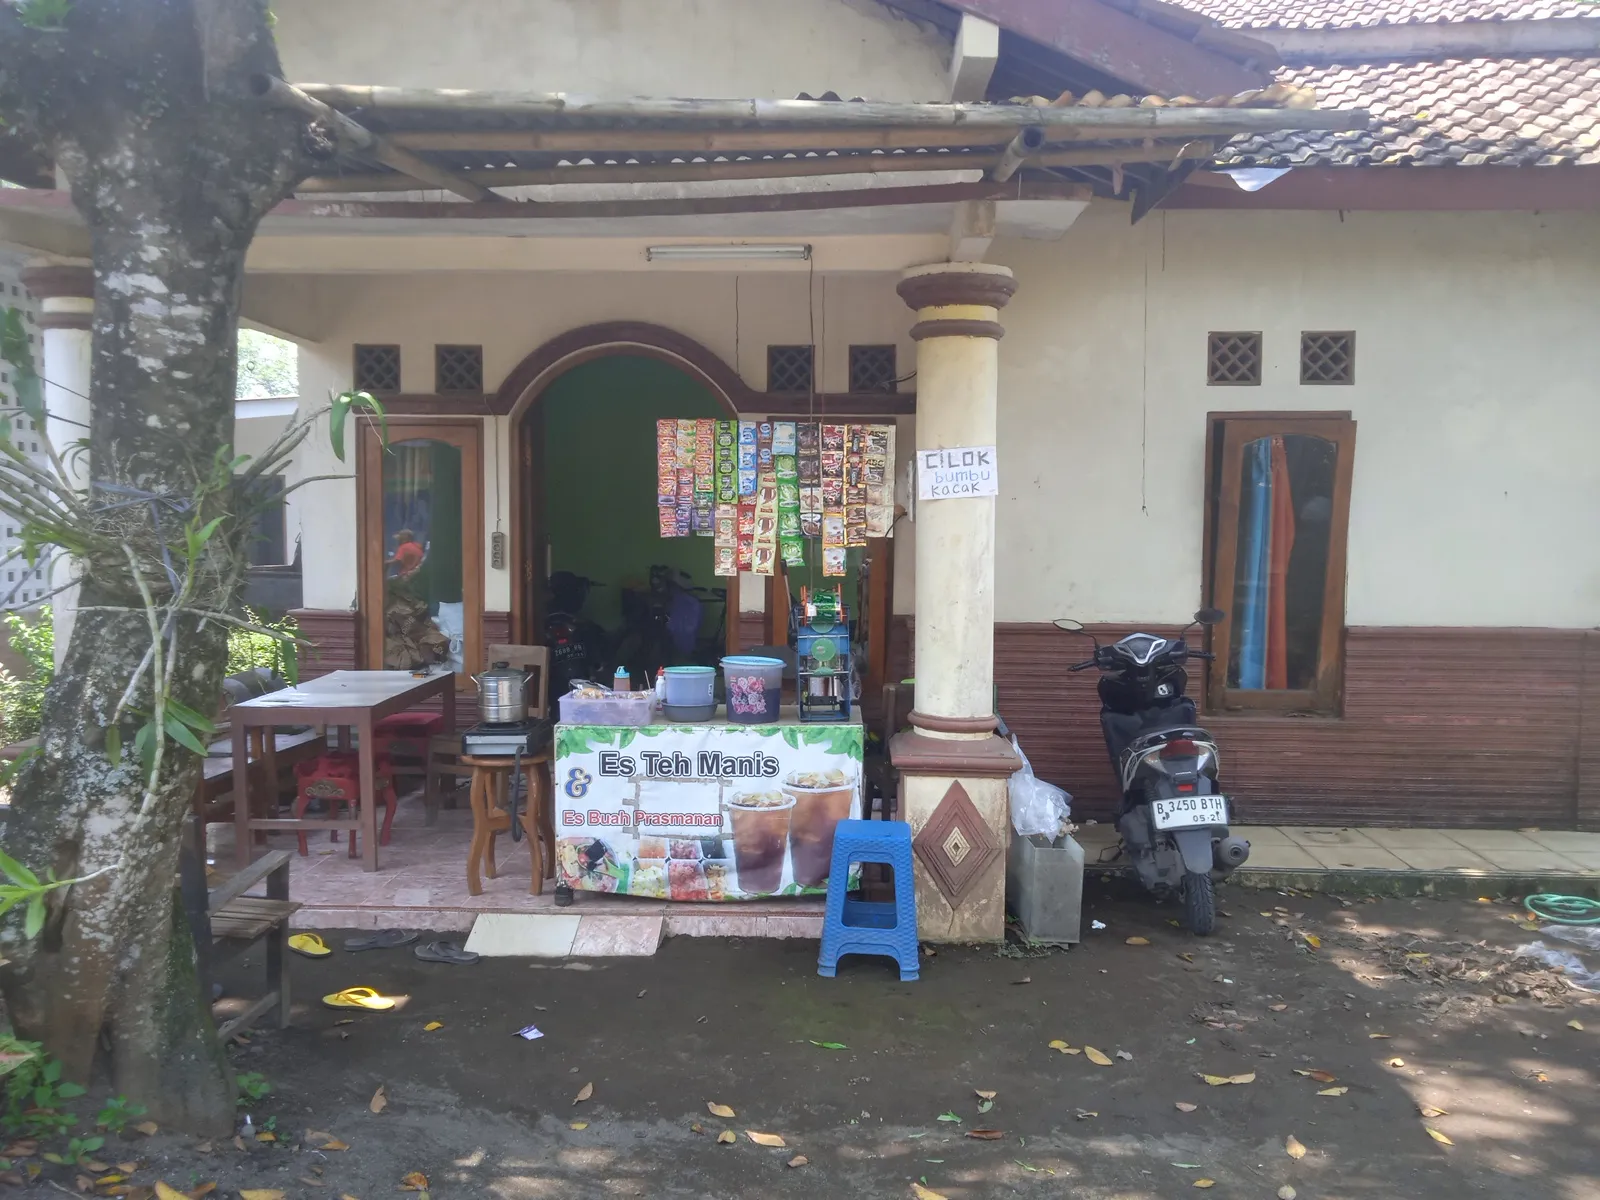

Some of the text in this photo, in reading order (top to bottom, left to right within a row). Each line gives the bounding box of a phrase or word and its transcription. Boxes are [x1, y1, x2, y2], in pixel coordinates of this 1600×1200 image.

[935, 470, 990, 483] bumbu
[599, 750, 780, 777] Es Teh Manis
[565, 767, 593, 798] &
[1156, 798, 1223, 815] B 3450 BTH
[562, 810, 724, 827] Es Buah Prasmanan
